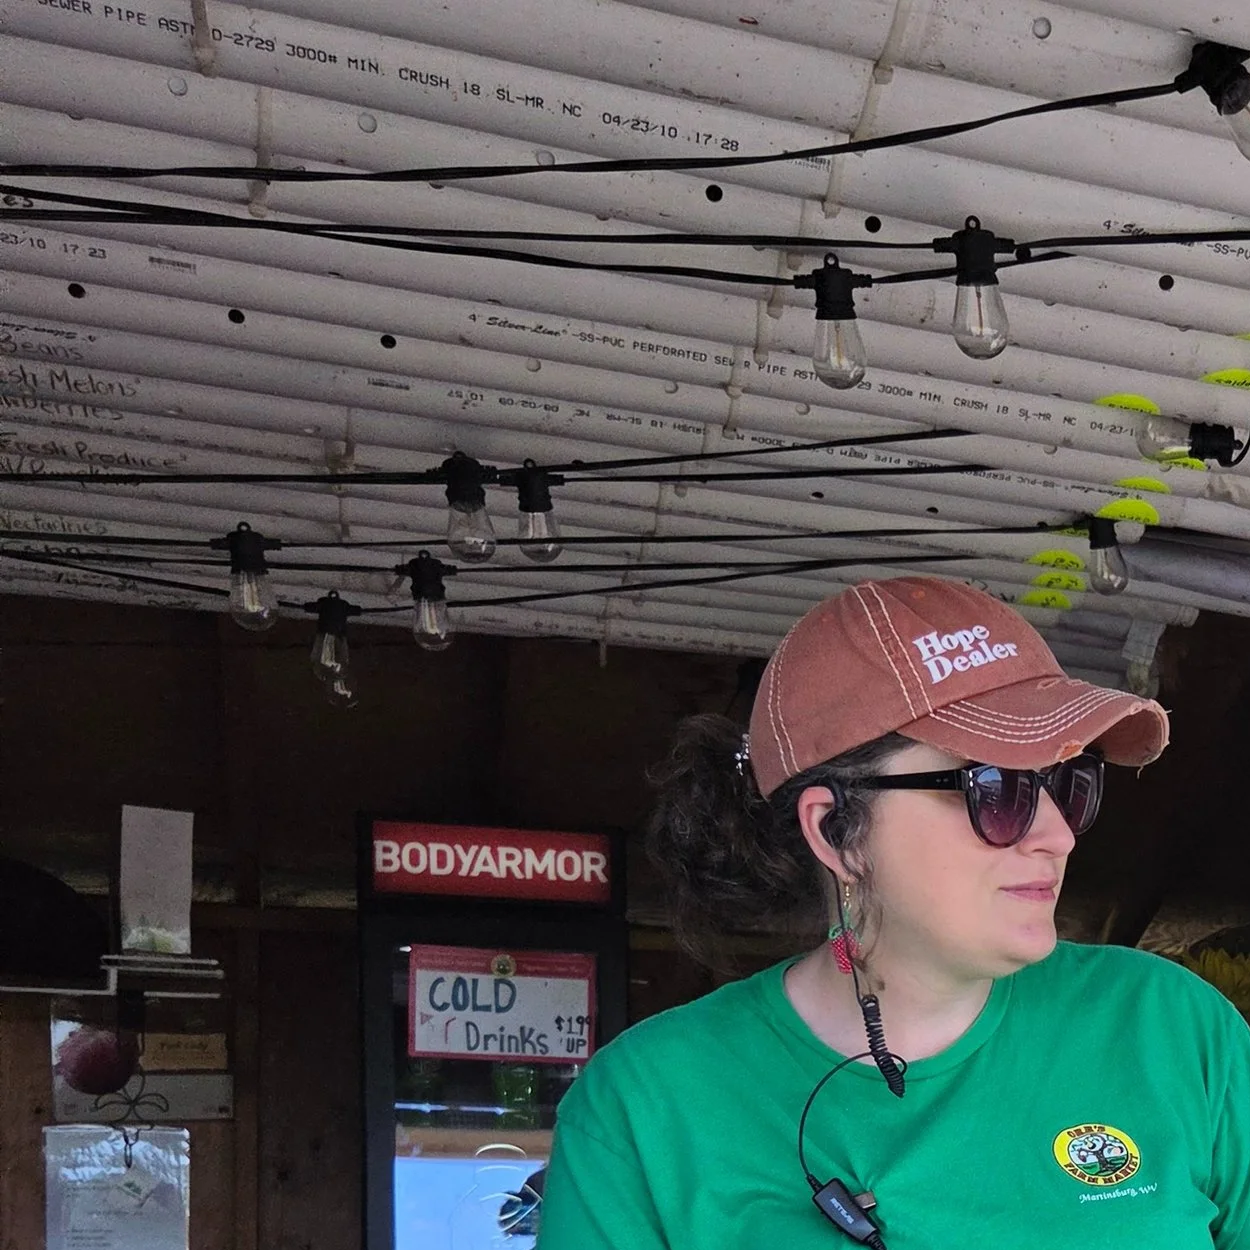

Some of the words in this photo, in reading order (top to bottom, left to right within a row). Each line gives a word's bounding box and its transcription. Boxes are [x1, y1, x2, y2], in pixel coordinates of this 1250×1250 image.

[104, 6, 147, 26] PIPE
[398, 67, 450, 90] CRUSH
[463, 81, 481, 96] 18
[562, 103, 582, 118] NC
[601, 112, 678, 139] 04/23/10
[632, 341, 708, 363] PERFORATED
[714, 354, 751, 370] SEWR
[758, 363, 788, 377] PIPE
[953, 396, 989, 413] CRUSH
[995, 404, 1010, 415] 18
[1063, 416, 1078, 427] NC
[1090, 421, 1134, 437] 04/23/1
[912, 625, 990, 661] Hope
[923, 640, 1019, 684] Dealer
[373, 839, 609, 883] BODYARMOR
[428, 977, 517, 1013] COLD
[1064, 1162, 1099, 1184] FARM
[1103, 1152, 1140, 1184] MARKET
